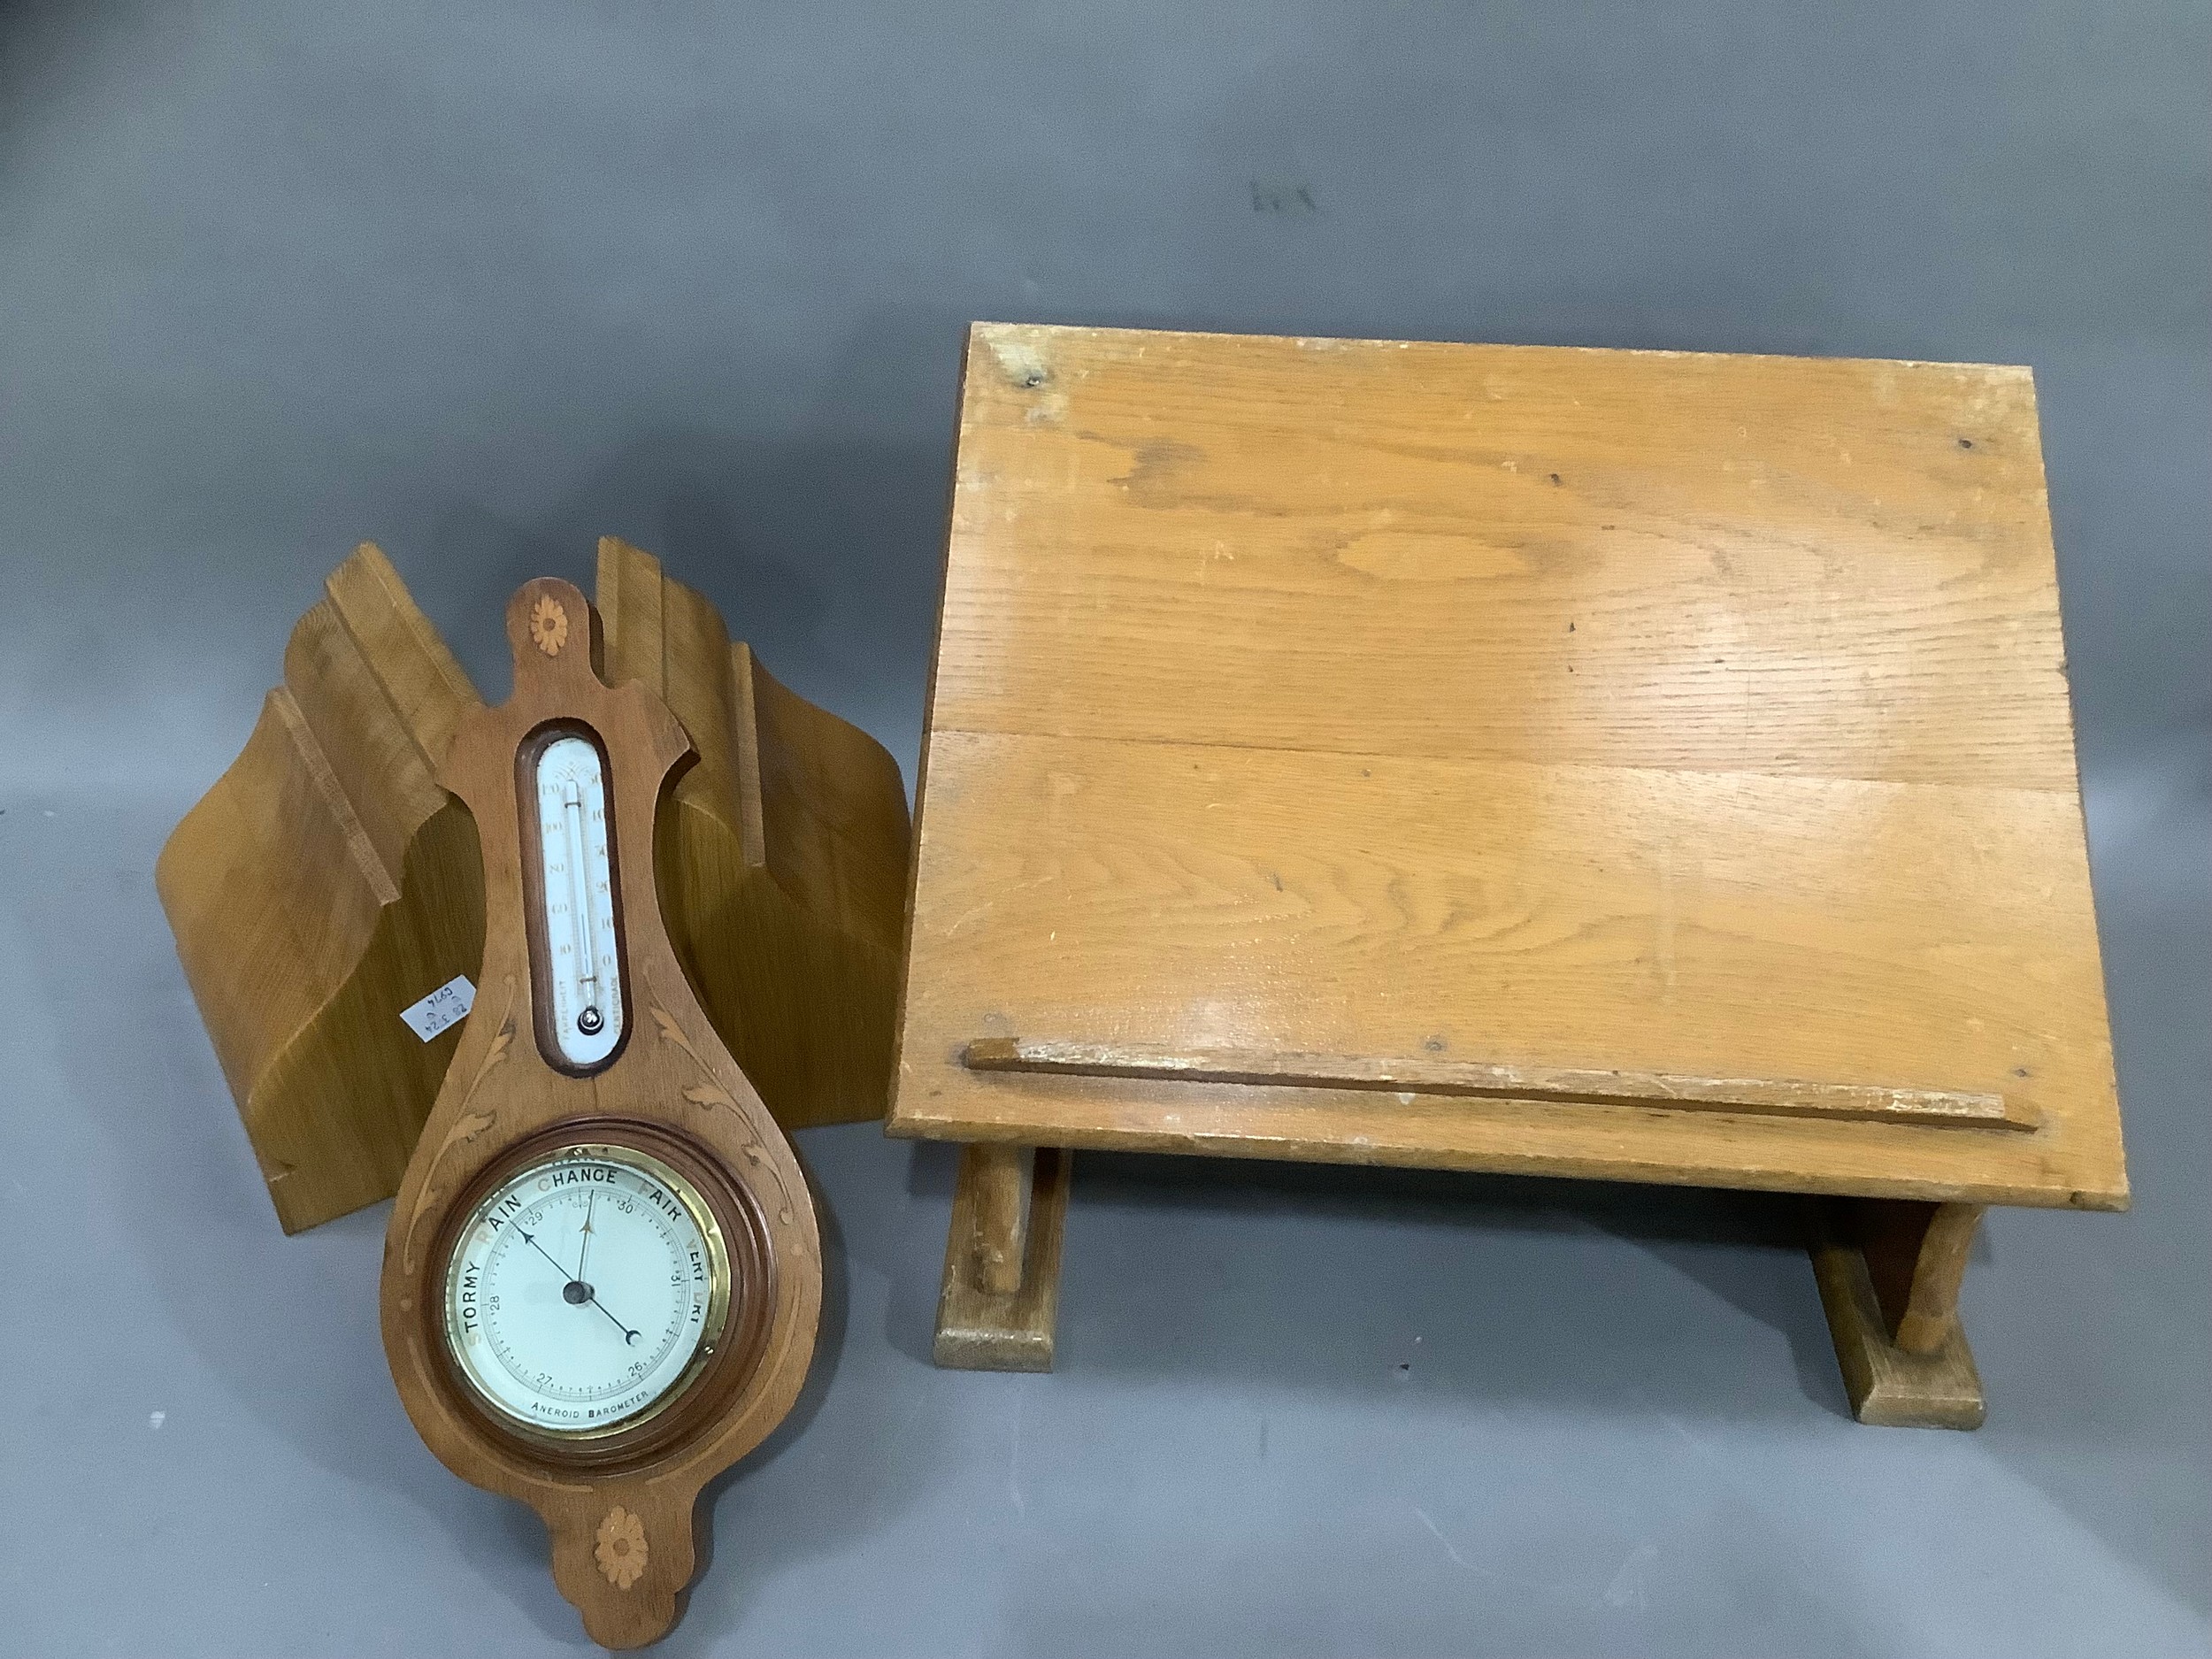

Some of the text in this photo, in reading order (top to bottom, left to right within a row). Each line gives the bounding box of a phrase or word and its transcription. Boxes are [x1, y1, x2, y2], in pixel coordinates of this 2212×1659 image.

[537, 1168, 618, 1193] CHANGE
[618, 1200, 634, 1215] 30
[638, 1179, 682, 1222] FAIR
[475, 1194, 522, 1245] RAIN
[528, 1211, 543, 1226] 29
[671, 1275, 681, 1287] 31
[462, 1261, 481, 1346] STORMY
[489, 1295, 500, 1310] 28
[627, 1362, 643, 1377] 26
[536, 1372, 553, 1386] 27
[531, 1390, 649, 1418] ANEROID BAROMETER
